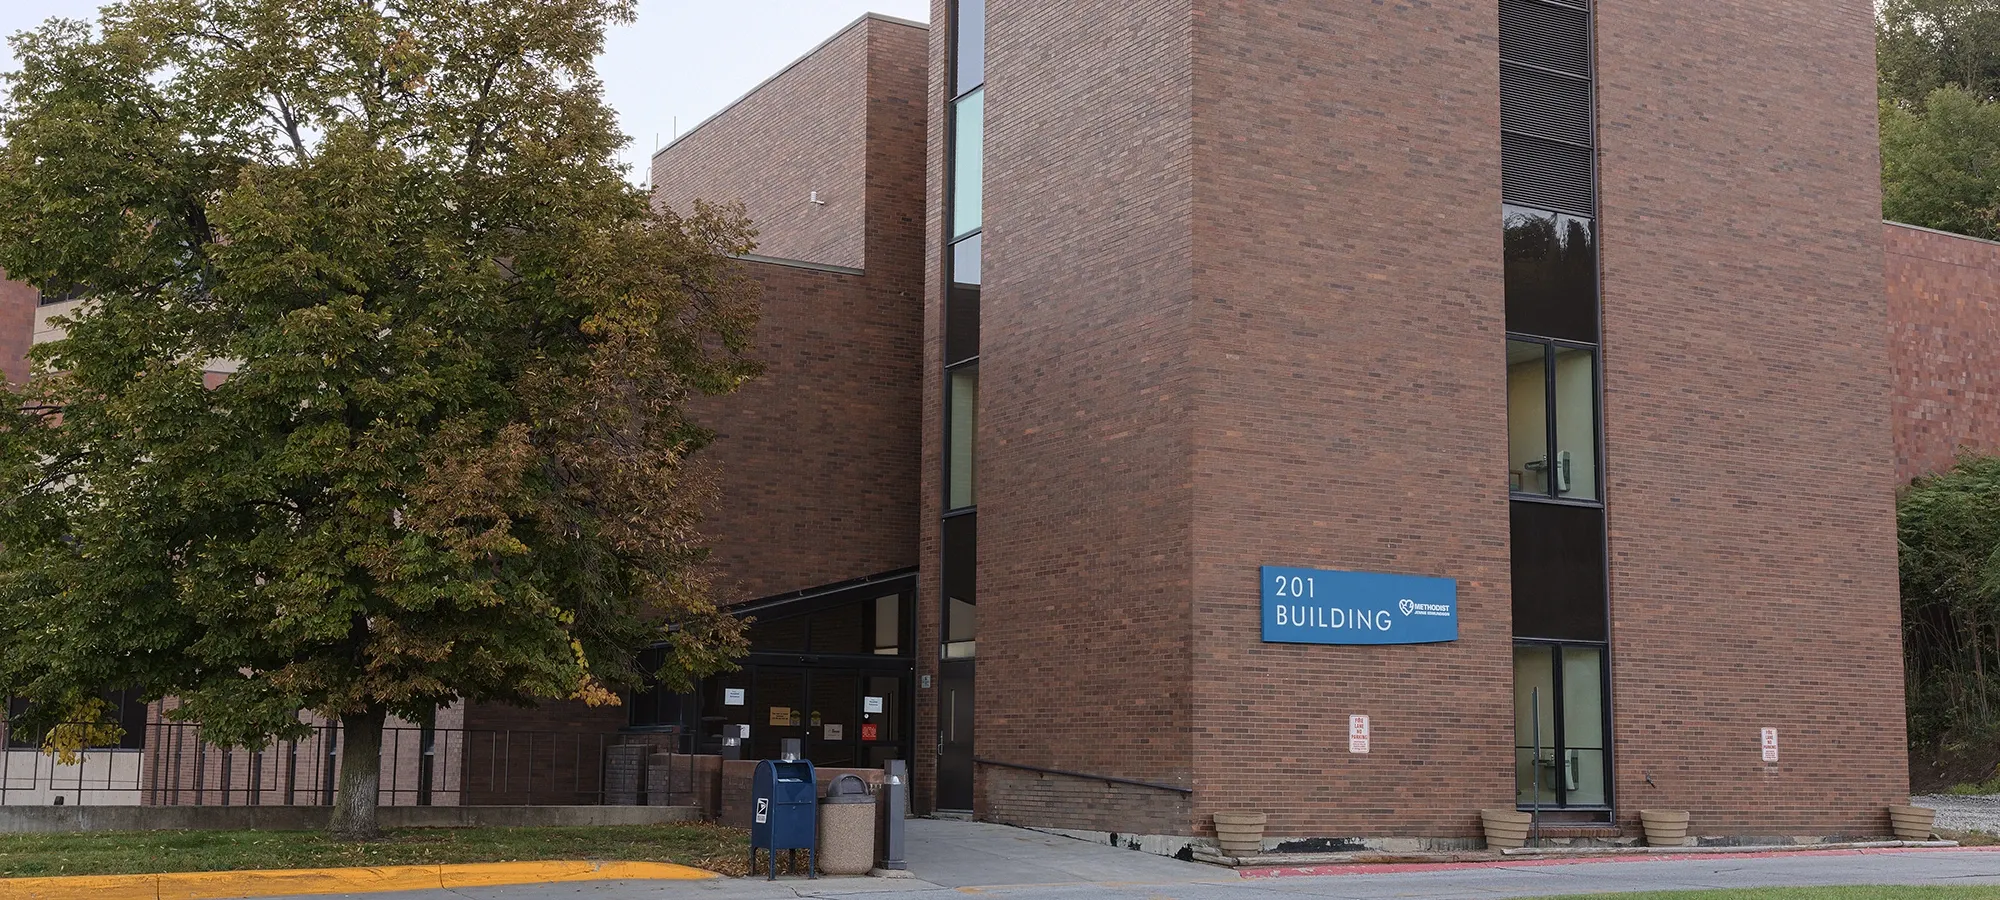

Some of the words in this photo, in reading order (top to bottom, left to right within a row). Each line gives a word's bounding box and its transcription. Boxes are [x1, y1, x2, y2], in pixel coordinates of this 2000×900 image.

[1275, 575, 1314, 598] 201
[1276, 605, 1392, 631] BUILDING
[1414, 603, 1450, 612] METHODIST
